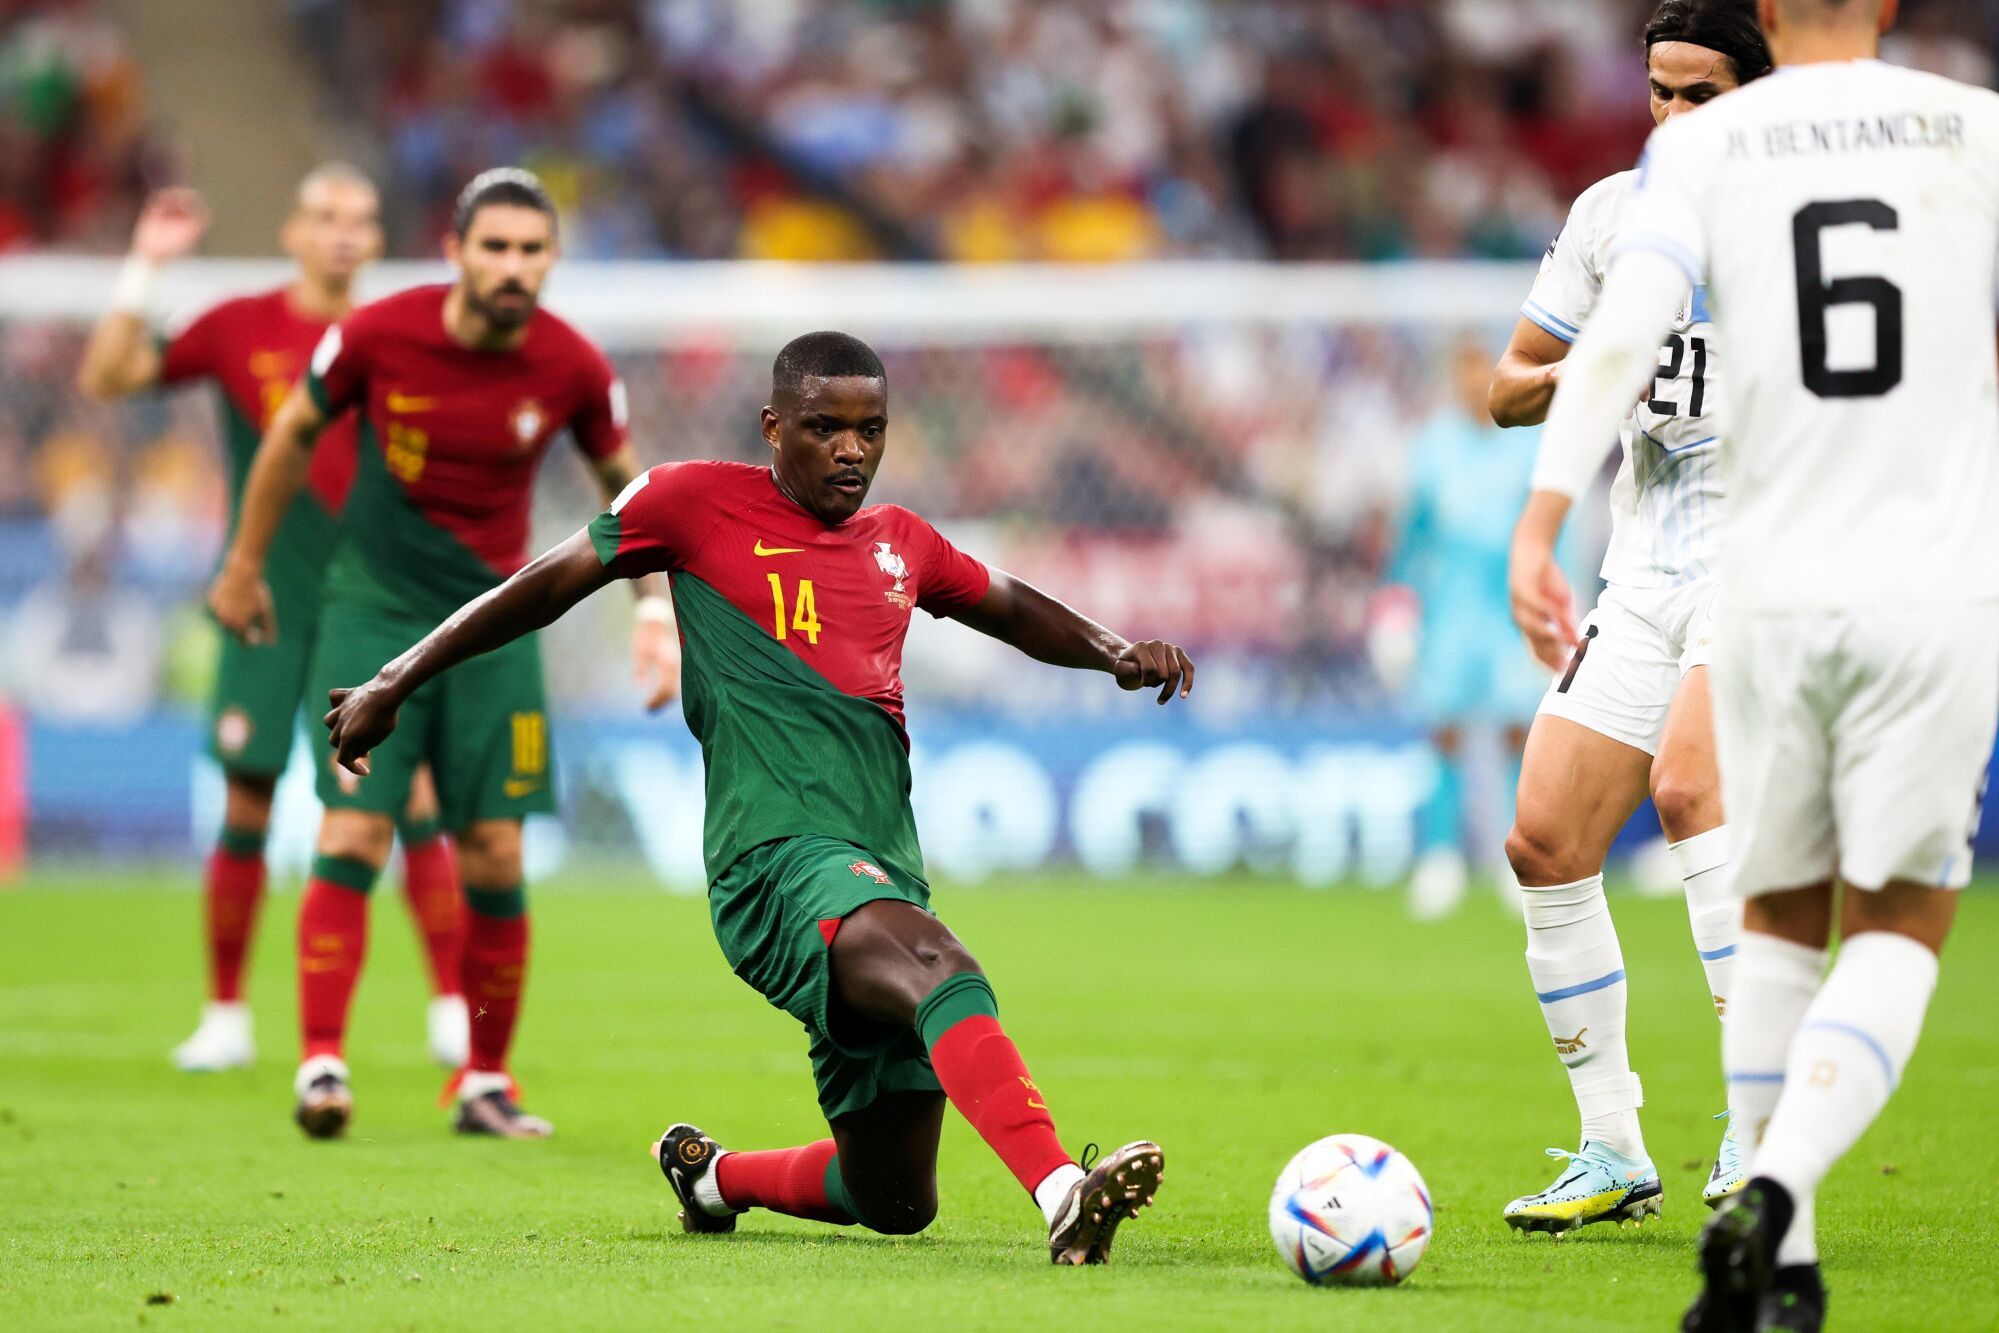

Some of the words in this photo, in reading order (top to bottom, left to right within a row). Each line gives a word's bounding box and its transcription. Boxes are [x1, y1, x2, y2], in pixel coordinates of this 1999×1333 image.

[1792, 199, 1904, 398] 6
[1648, 333, 1706, 418] 21
[767, 573, 822, 645] 14
